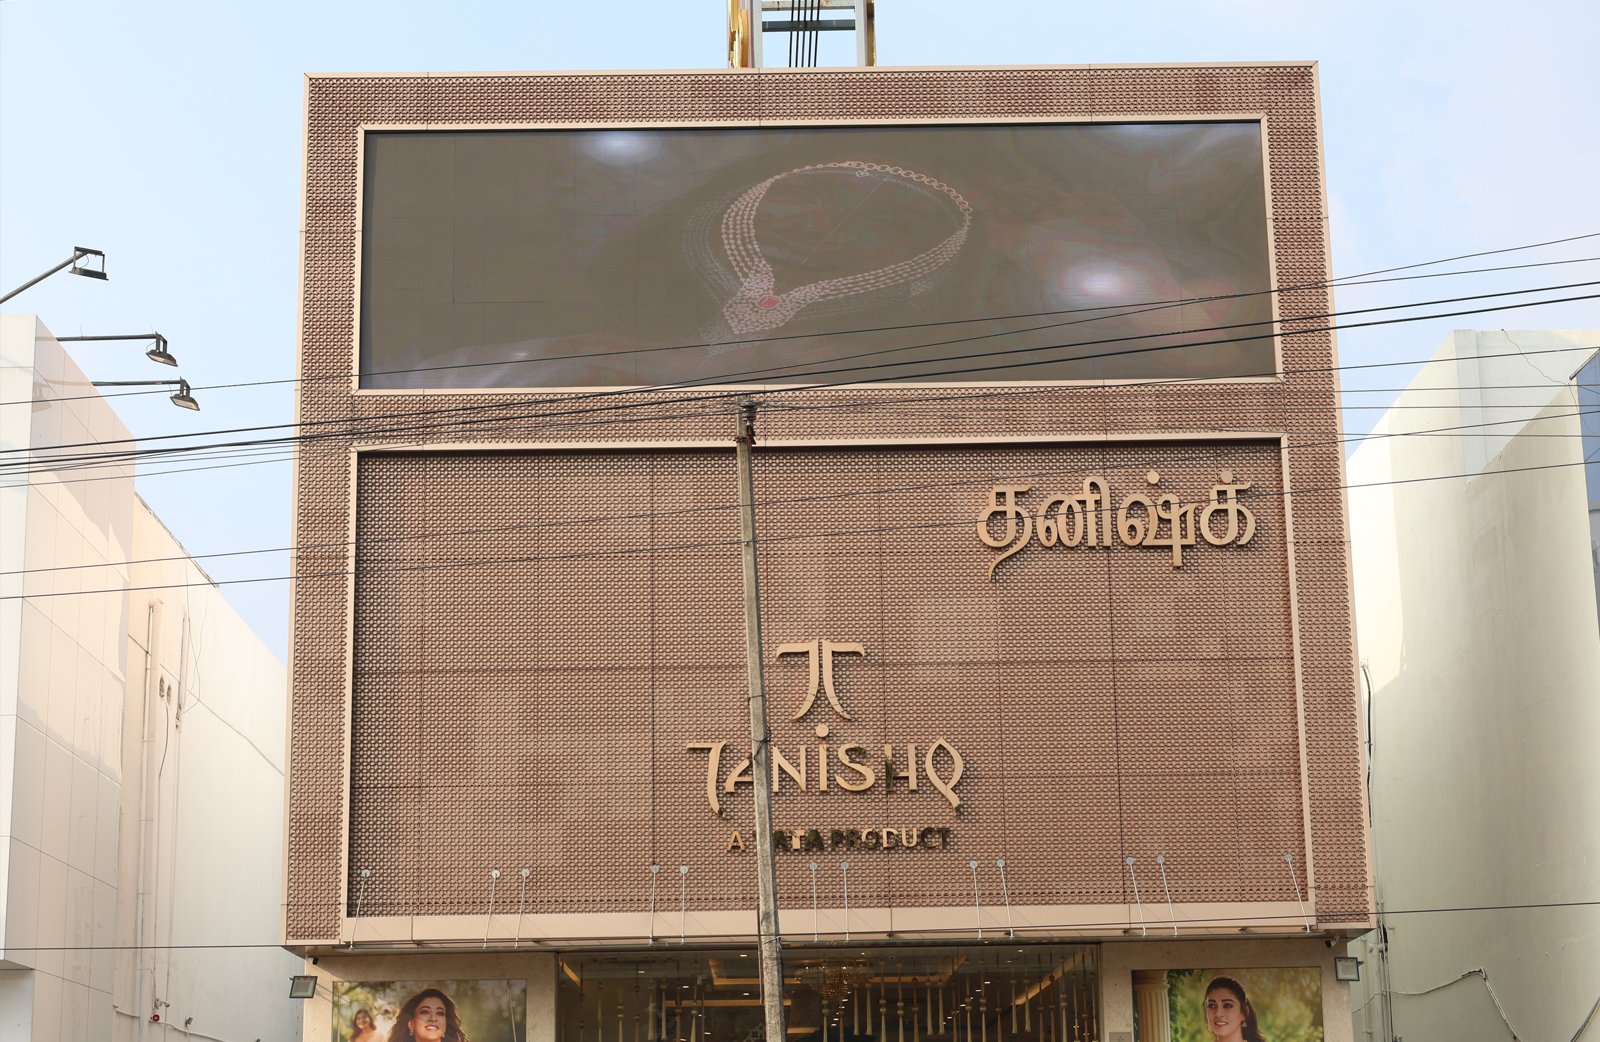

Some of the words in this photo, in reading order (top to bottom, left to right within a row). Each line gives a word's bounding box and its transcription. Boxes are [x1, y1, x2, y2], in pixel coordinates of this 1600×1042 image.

[976, 470, 1256, 582] தனிஷ்க்
[728, 830, 745, 850] A
[753, 829, 824, 850] ATA
[831, 827, 950, 849] PRODUCT
